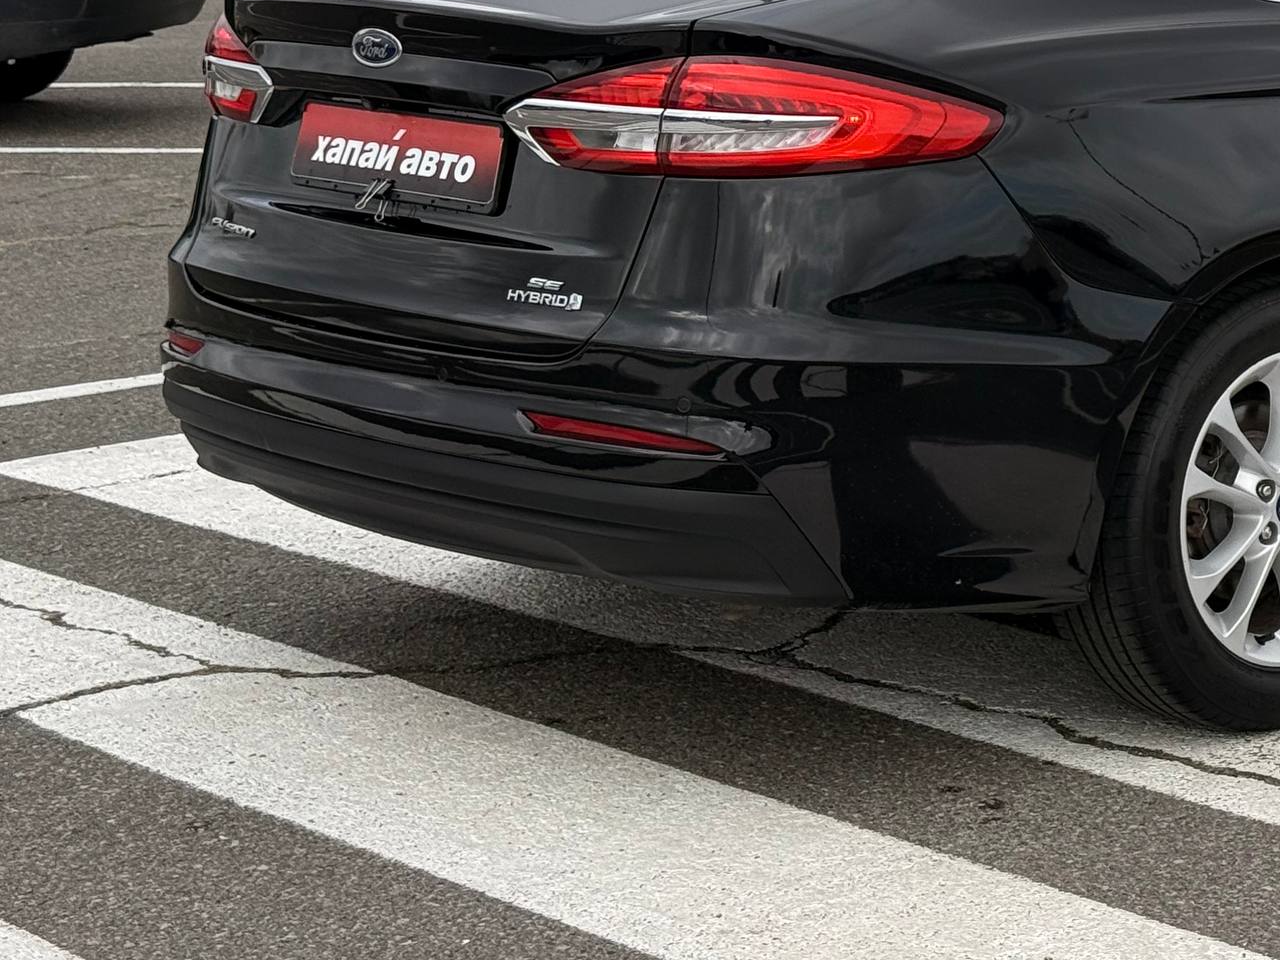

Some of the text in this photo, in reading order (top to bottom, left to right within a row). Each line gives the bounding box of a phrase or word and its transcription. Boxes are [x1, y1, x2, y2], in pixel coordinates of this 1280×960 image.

[311, 128, 476, 183] хапай авто
[527, 277, 565, 291] SE
[506, 289, 568, 307] HYBRID
